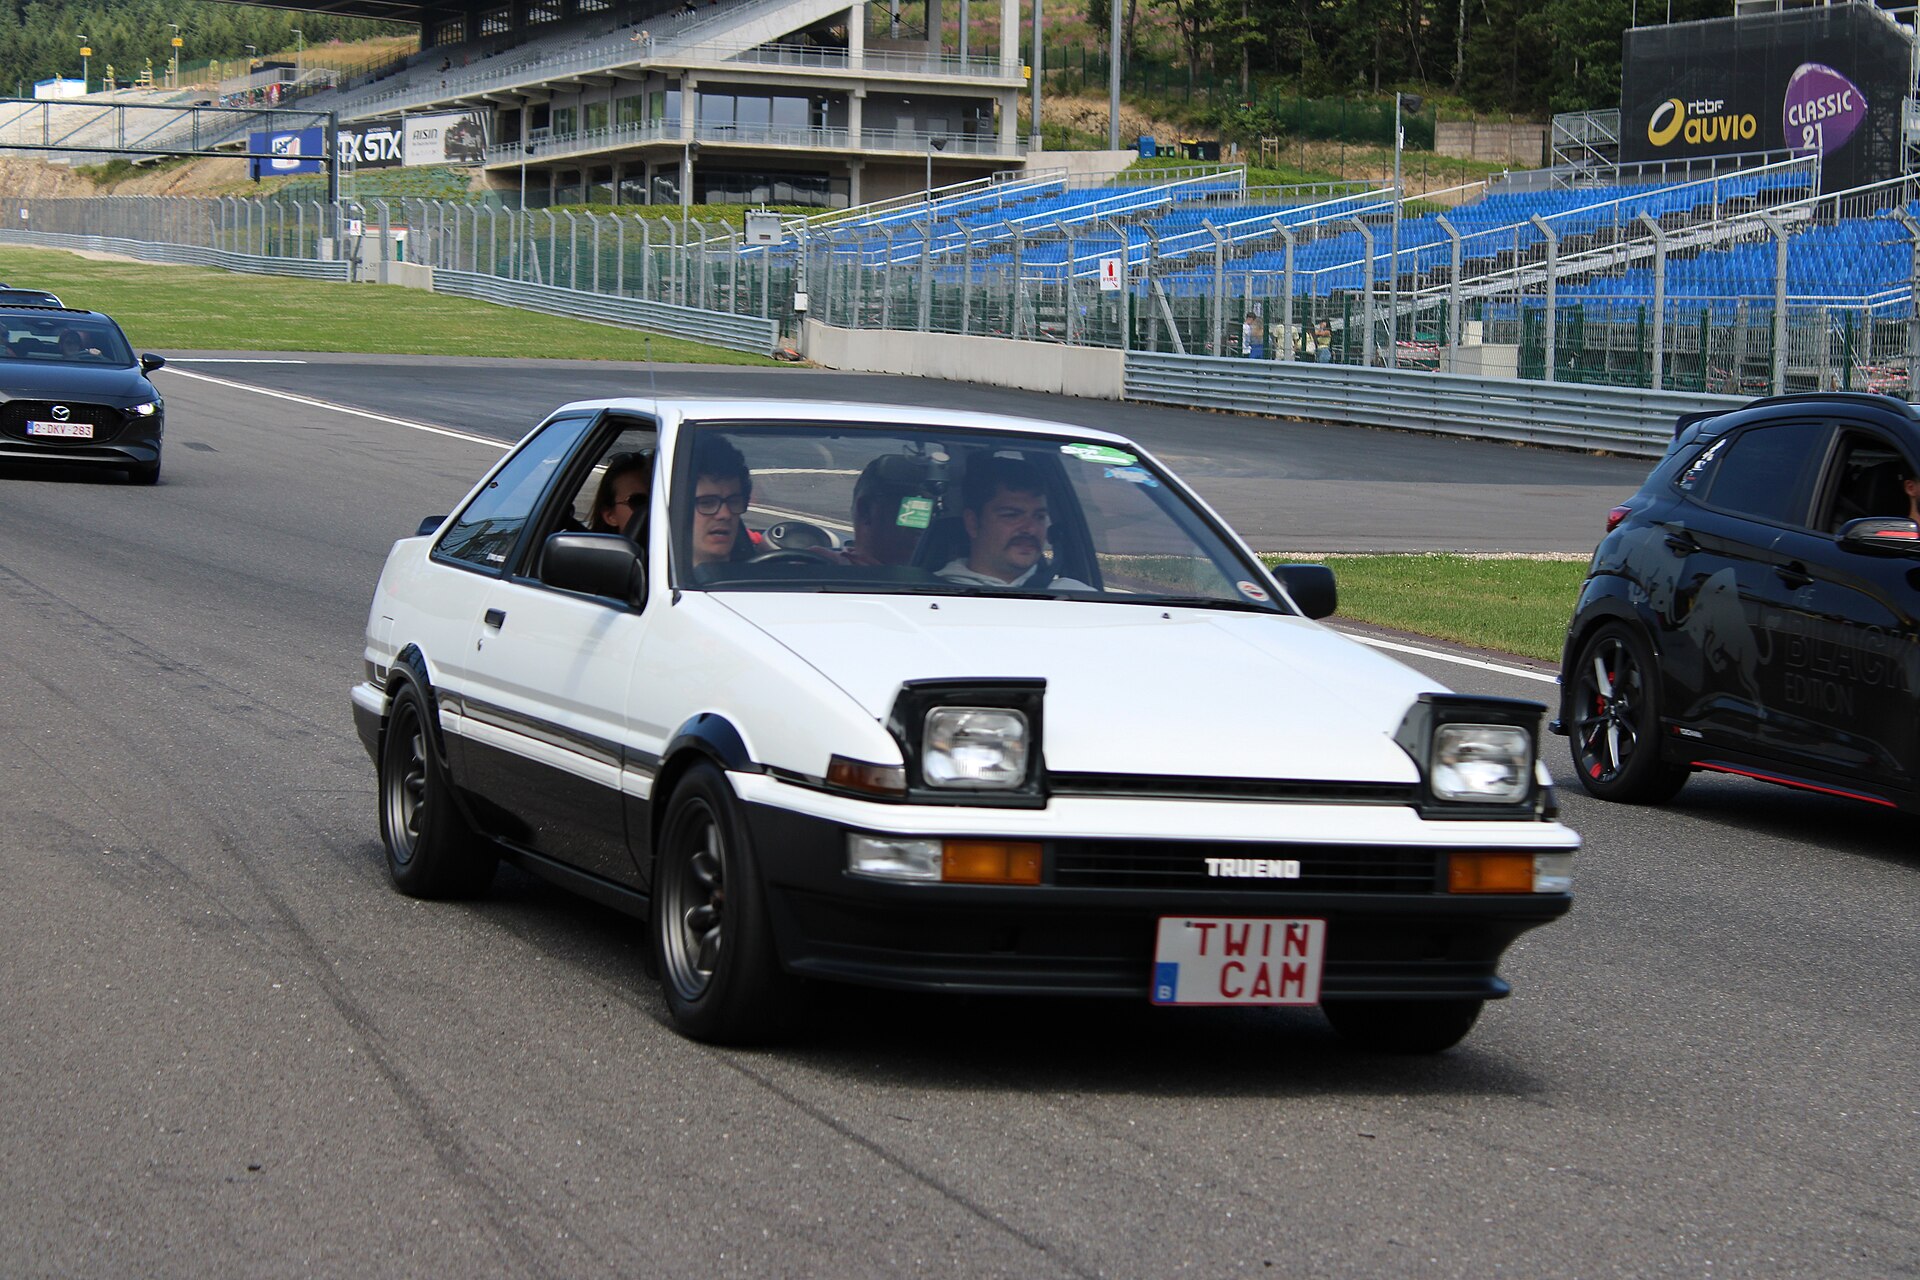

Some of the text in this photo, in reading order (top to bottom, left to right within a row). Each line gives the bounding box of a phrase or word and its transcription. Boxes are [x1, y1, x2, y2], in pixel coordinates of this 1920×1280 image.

[1688, 99, 1724, 115] rtbf
[1788, 90, 1852, 127] CLASSIC
[364, 131, 402, 161] STX
[1802, 123, 1823, 150] 21
[1204, 858, 1300, 878] TRUENO
[1189, 922, 1310, 957] TWIN
[1158, 986, 1172, 999] B
[1219, 961, 1307, 998] CAM
